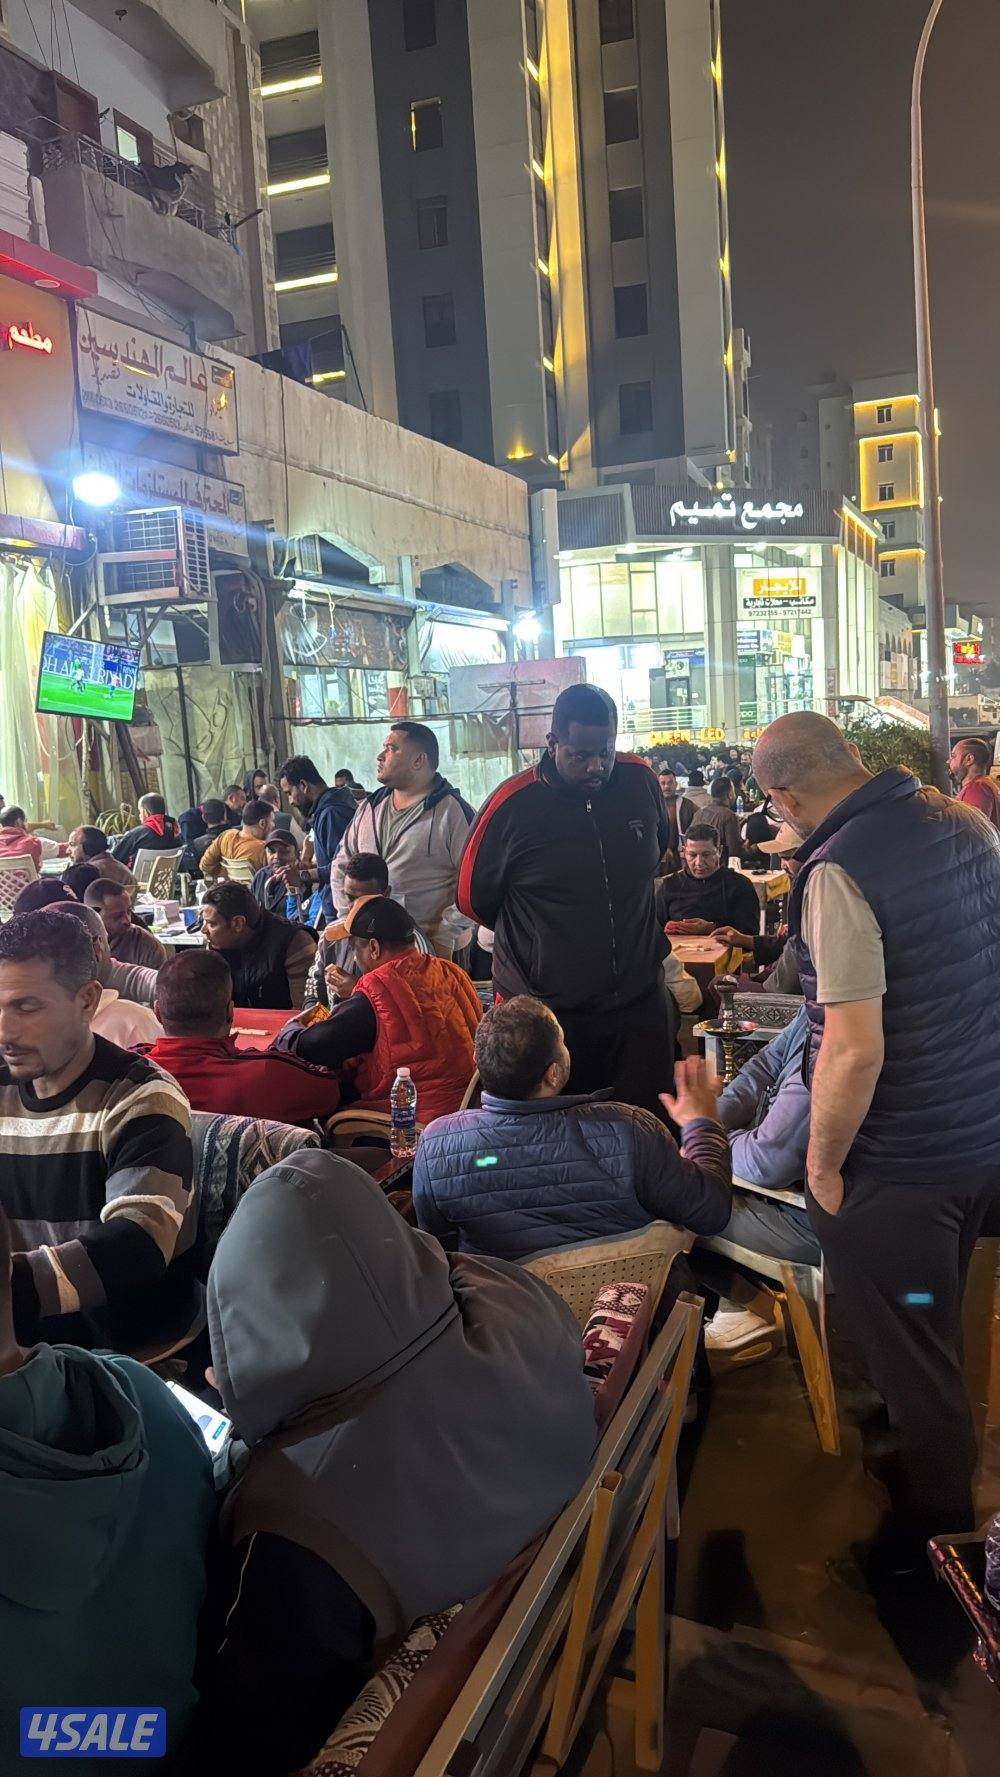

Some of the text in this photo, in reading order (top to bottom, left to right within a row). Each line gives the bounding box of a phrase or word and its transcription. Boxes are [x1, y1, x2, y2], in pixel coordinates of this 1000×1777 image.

[8, 320, 53, 354] مطعم
[669, 492, 804, 529] مجمع تميم
[700, 727, 725, 742] LED
